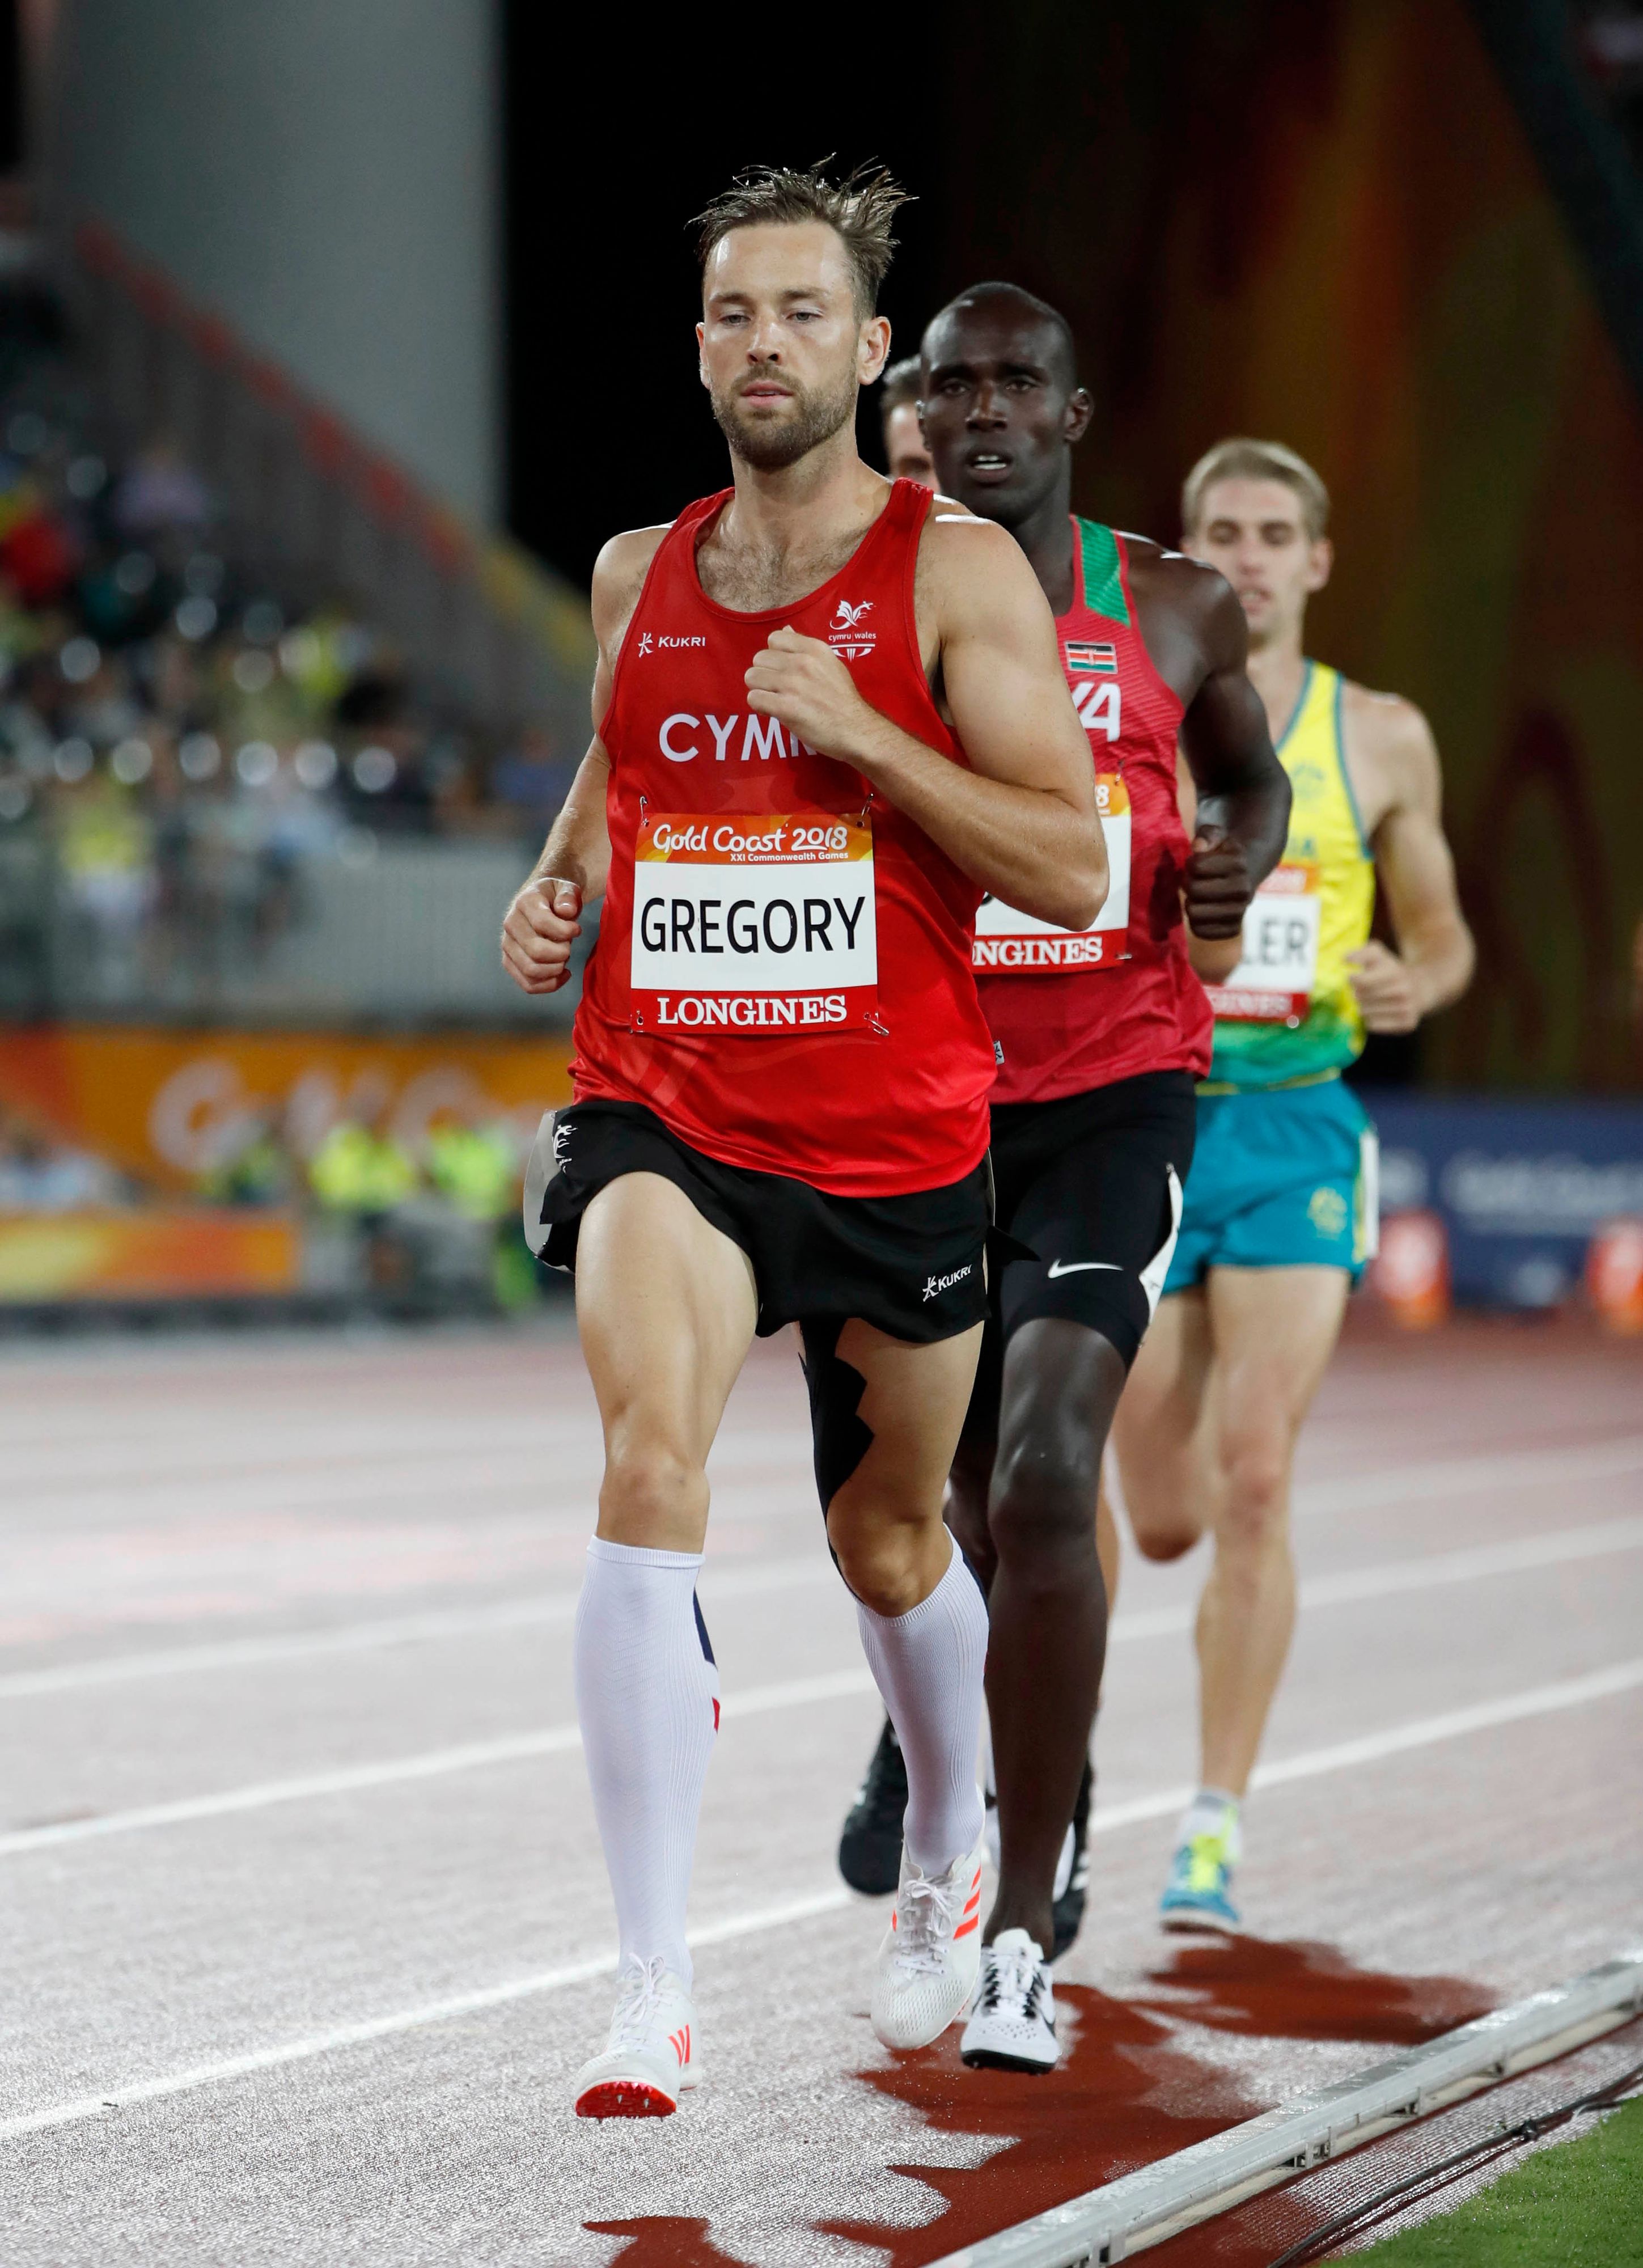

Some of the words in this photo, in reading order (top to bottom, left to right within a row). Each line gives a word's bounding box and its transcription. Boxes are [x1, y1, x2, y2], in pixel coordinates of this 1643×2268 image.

[658, 636, 706, 648] KUKRI
[828, 633, 852, 642] cymru
[653, 824, 708, 853] Gold
[712, 826, 787, 852] Coast
[791, 826, 848, 852] 2018
[730, 853, 746, 862] XXI
[747, 852, 816, 862] Commonwealth
[818, 852, 849, 860] Games
[641, 896, 866, 954] GREGORY
[972, 936, 1103, 966] NGINES
[1245, 917, 1309, 968] ER
[657, 995, 848, 1026] LONGINES
[938, 1263, 973, 1292] KUKRI
